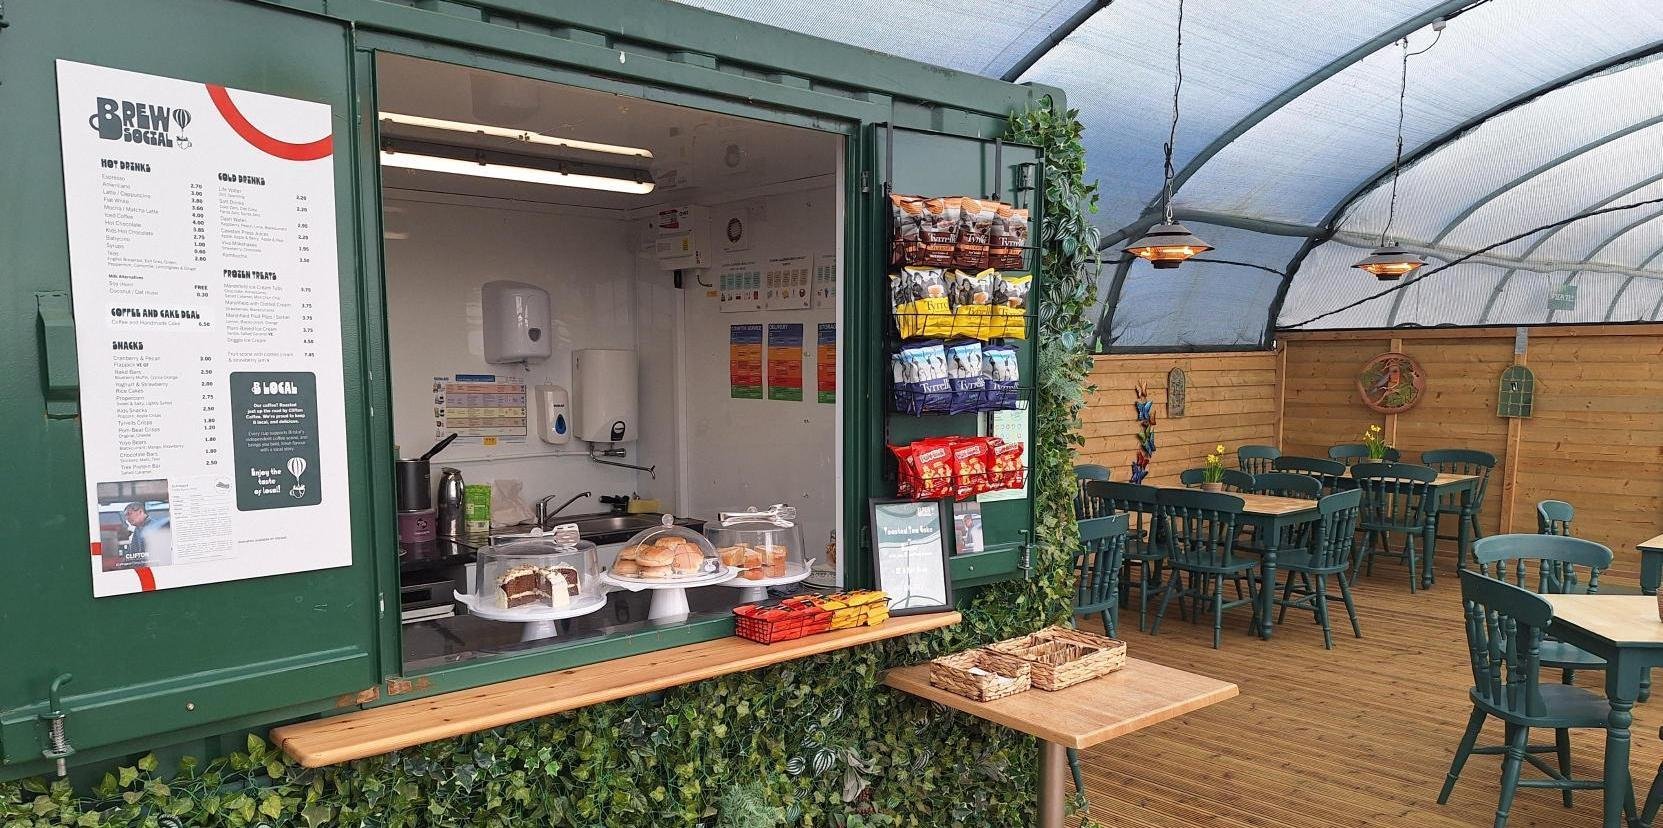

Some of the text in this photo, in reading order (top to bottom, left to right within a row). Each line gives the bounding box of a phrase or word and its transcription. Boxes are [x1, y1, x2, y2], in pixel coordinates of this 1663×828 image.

[90, 97, 170, 141] BREW
[124, 127, 173, 148] SOCIAL
[101, 159, 151, 172] HOT DRINKS
[218, 172, 266, 186] COLD DRINKS
[223, 269, 278, 281] FROZEN TREATS
[111, 308, 201, 320] COFFEE AND CAKE DEAL
[112, 341, 144, 351] SNACKS
[252, 382, 299, 395] B LOCAL
[251, 467, 282, 479] Enjoy the
[258, 478, 277, 486] taste
[254, 484, 282, 497] of local!
